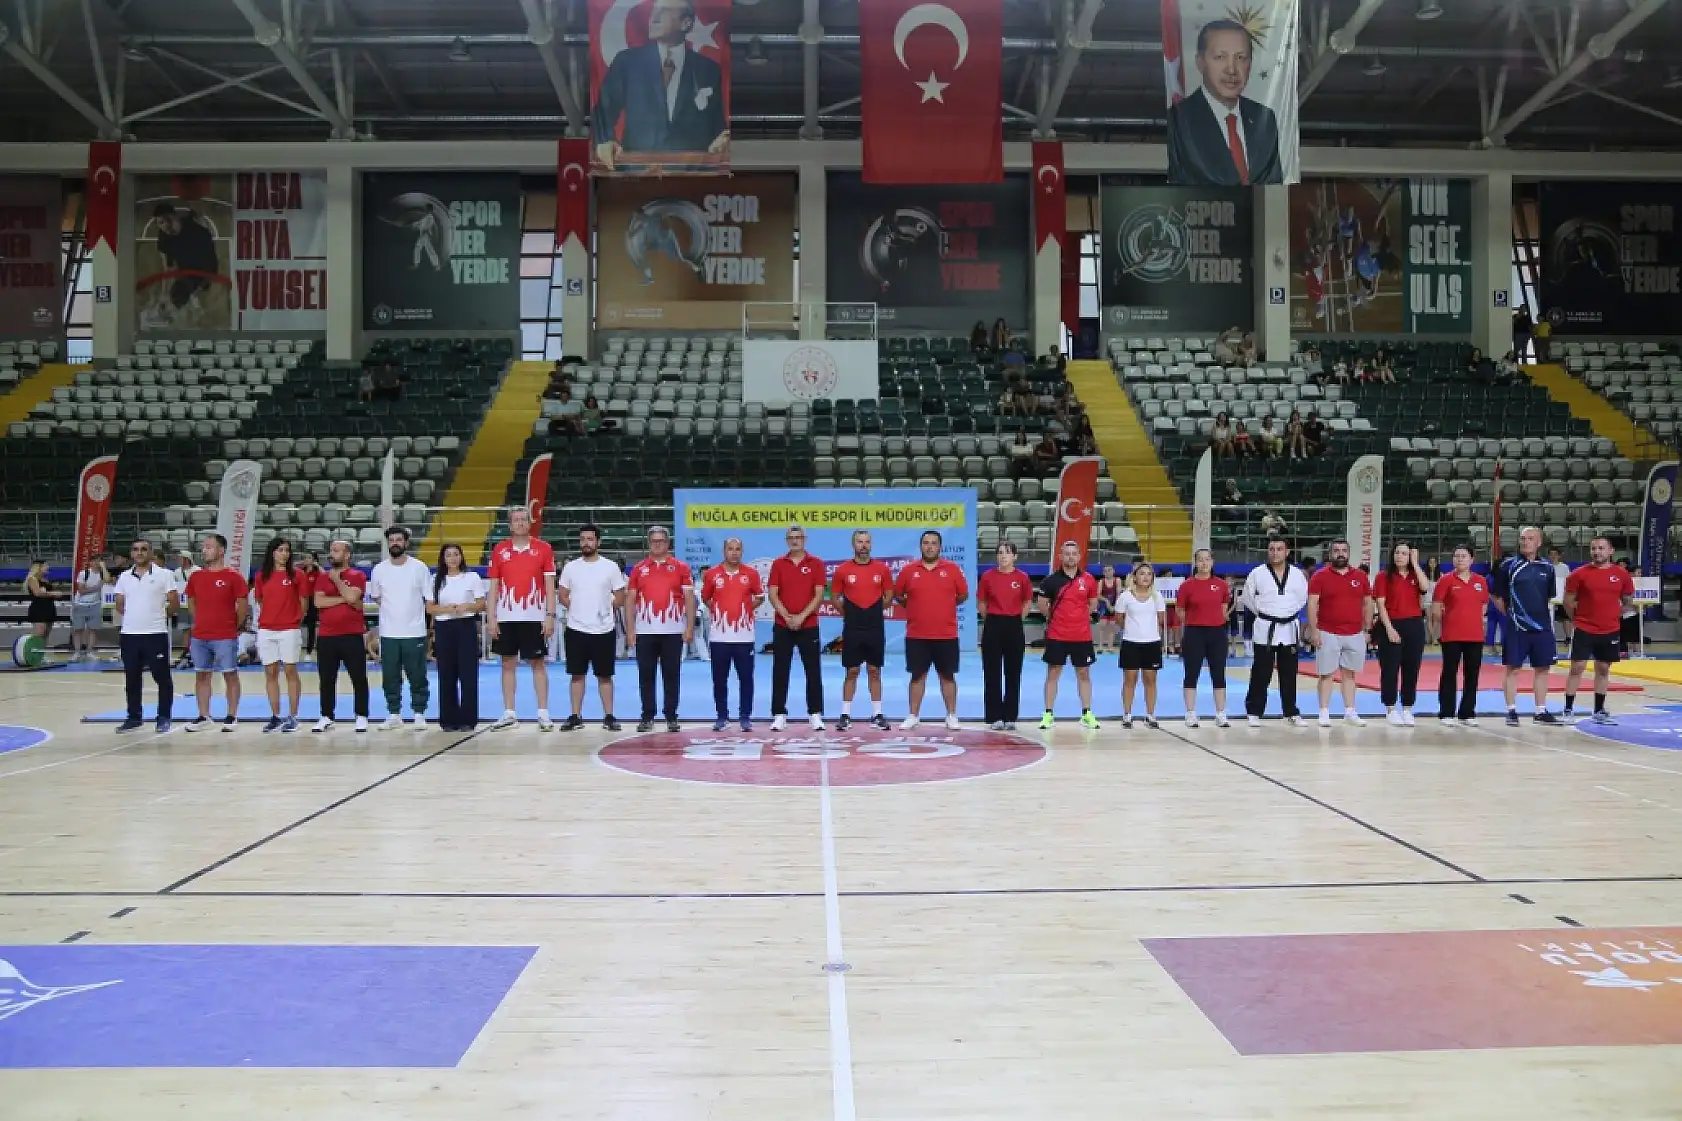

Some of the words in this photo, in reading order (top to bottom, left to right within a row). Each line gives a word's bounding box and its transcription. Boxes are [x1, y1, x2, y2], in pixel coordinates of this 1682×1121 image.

[449, 200, 502, 227] SPOR
[703, 194, 760, 223] SPOR
[1185, 201, 1236, 227] SPOR
[1621, 205, 1673, 232] SPOR
[451, 230, 486, 255] HER
[706, 226, 742, 254] HER
[1186, 229, 1221, 254] HER
[1409, 220, 1461, 265] SEĞE
[1621, 234, 1659, 262] HER
[450, 257, 509, 284] YERDE
[703, 257, 766, 285] YERDE
[1187, 258, 1242, 284] YERDE
[1621, 266, 1680, 293] YERDE
[1410, 273, 1462, 319] ULAŞ
[692, 508, 738, 522] MUĞLA
[741, 508, 797, 525] GENÇLİK
[803, 510, 818, 522] VE
[822, 510, 857, 522] SPOR
[861, 508, 872, 522] İL
[875, 507, 959, 522] MÜDÜRLÜĞÜ
[682, 743, 966, 761] GSB
